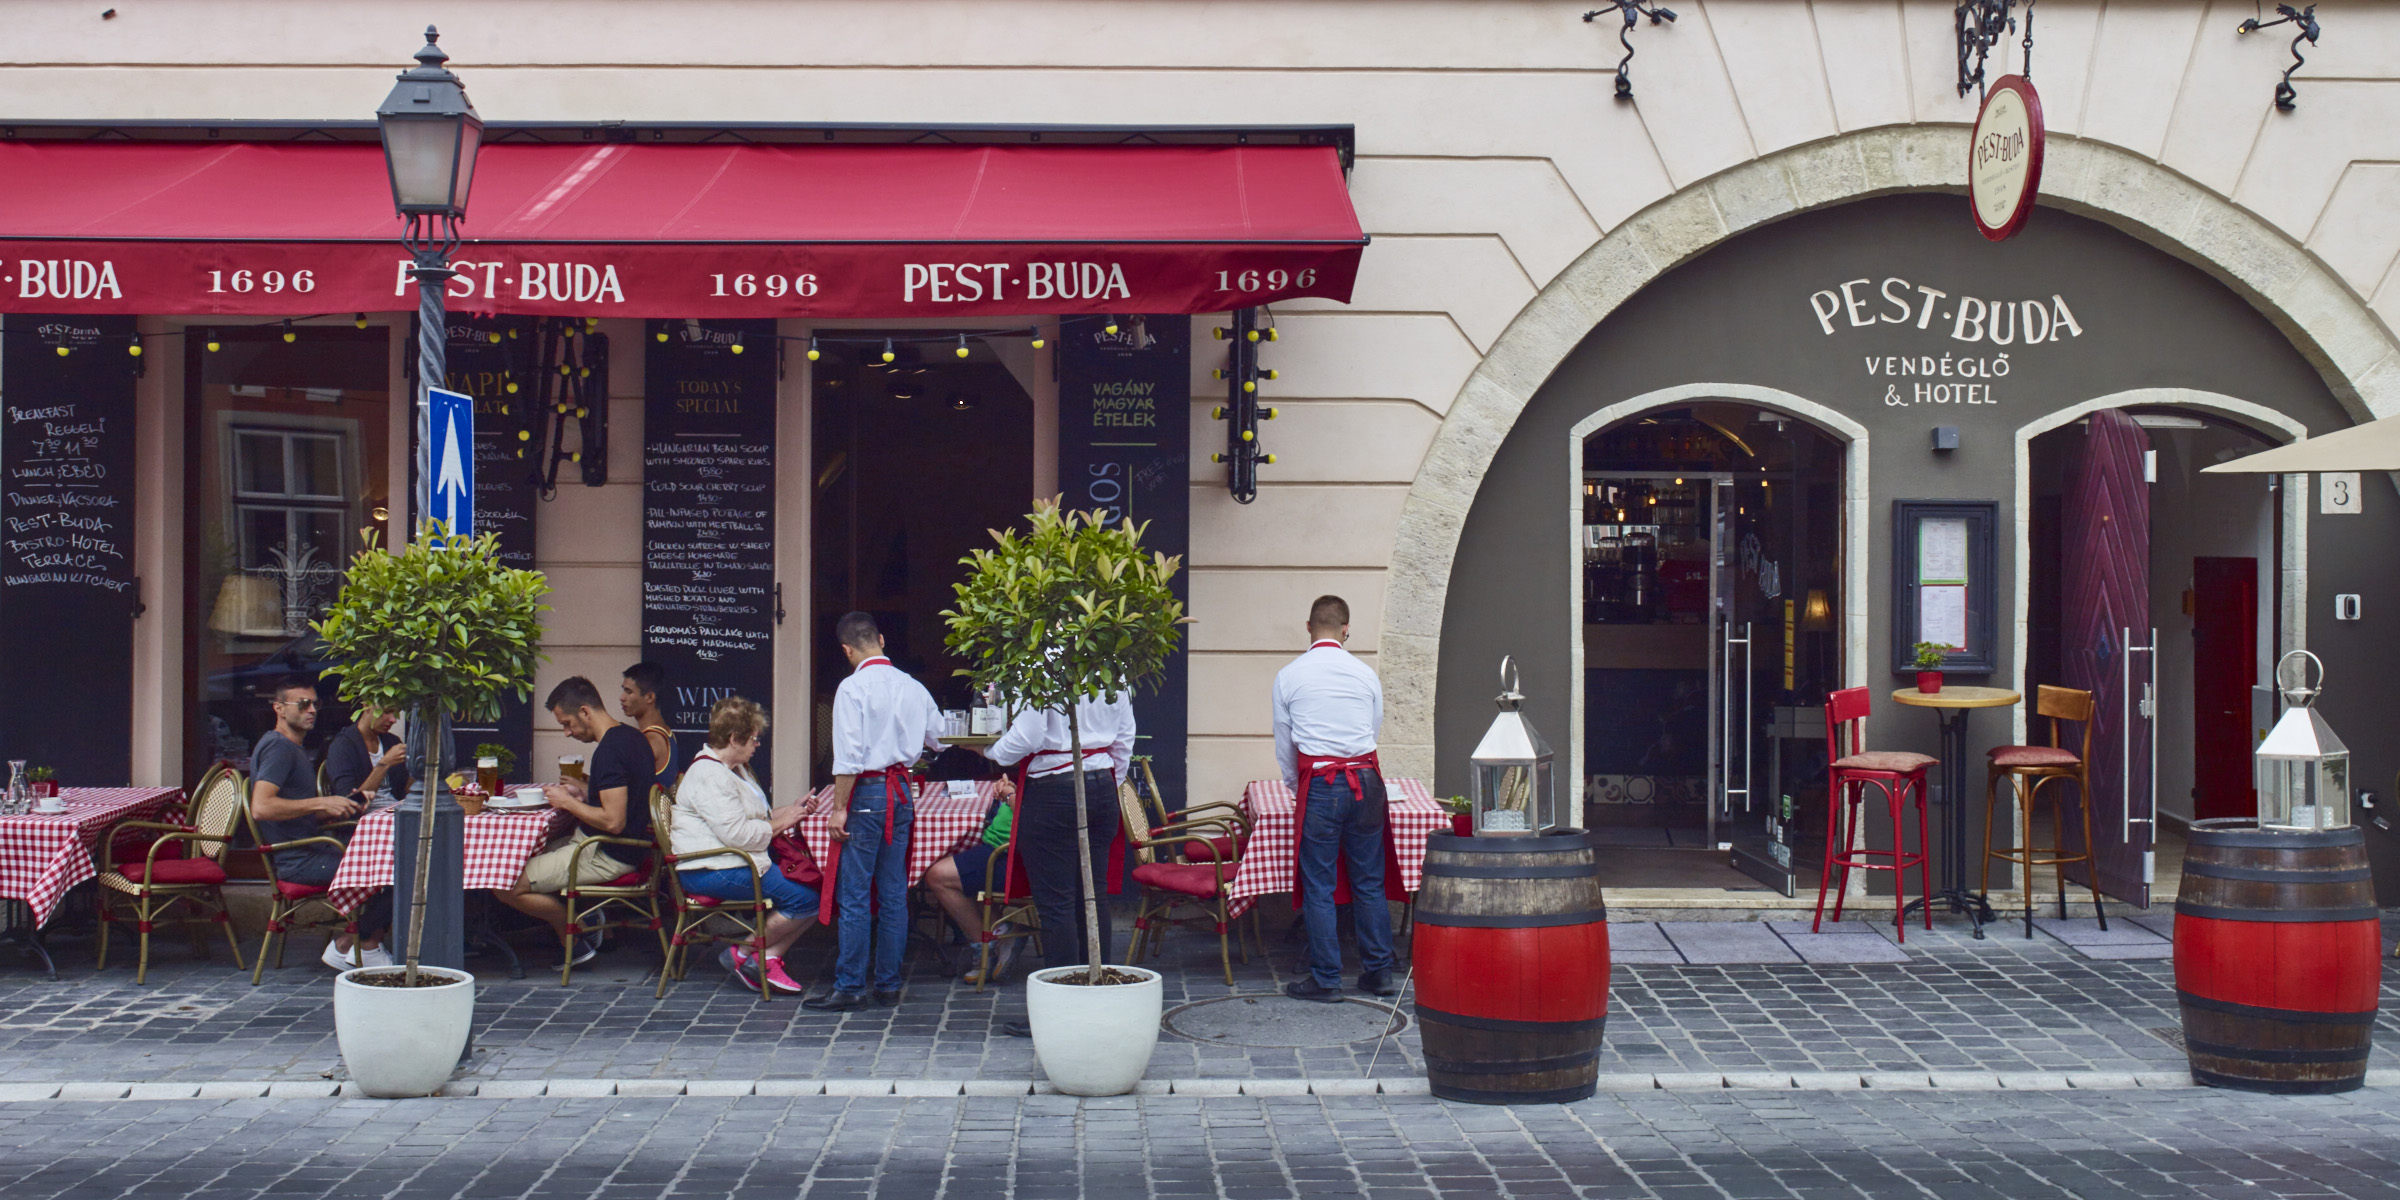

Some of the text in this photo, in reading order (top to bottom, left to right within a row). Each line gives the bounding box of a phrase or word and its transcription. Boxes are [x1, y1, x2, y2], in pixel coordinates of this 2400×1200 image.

[207, 270, 316, 294] 1696
[395, 260, 625, 303] PST·BUDA
[710, 273, 818, 298] 1696
[1213, 268, 1316, 292] 1696
[1093, 378, 1155, 396] VAGÁNY
[1884, 382, 1997, 407] & HOTEL
[676, 398, 742, 414] SPECIAL
[1093, 397, 1155, 411] MAGYAR
[8, 404, 76, 424] BREAKFAST
[1093, 410, 1156, 427] ÉTELEK
[713, 444, 738, 454] BEAN
[740, 444, 769, 454] SOUP
[645, 458, 670, 466] WITH
[716, 457, 745, 466] SPARE
[680, 481, 704, 491] SOUR
[706, 482, 738, 492] CHERRY
[740, 484, 766, 493] SOUP
[2333, 480, 2349, 506] 3
[686, 520, 707, 529] WITH
[740, 542, 771, 550] SHEEP
[21, 553, 107, 571] TERRACE
[647, 552, 686, 561] CHEESE
[5, 572, 131, 592] HUNGARIAN KITCHEN
[644, 582, 765, 595] ROASTED DUCK LIVER WITH
[699, 626, 743, 638] PANCAKE
[745, 631, 769, 639] WITH
